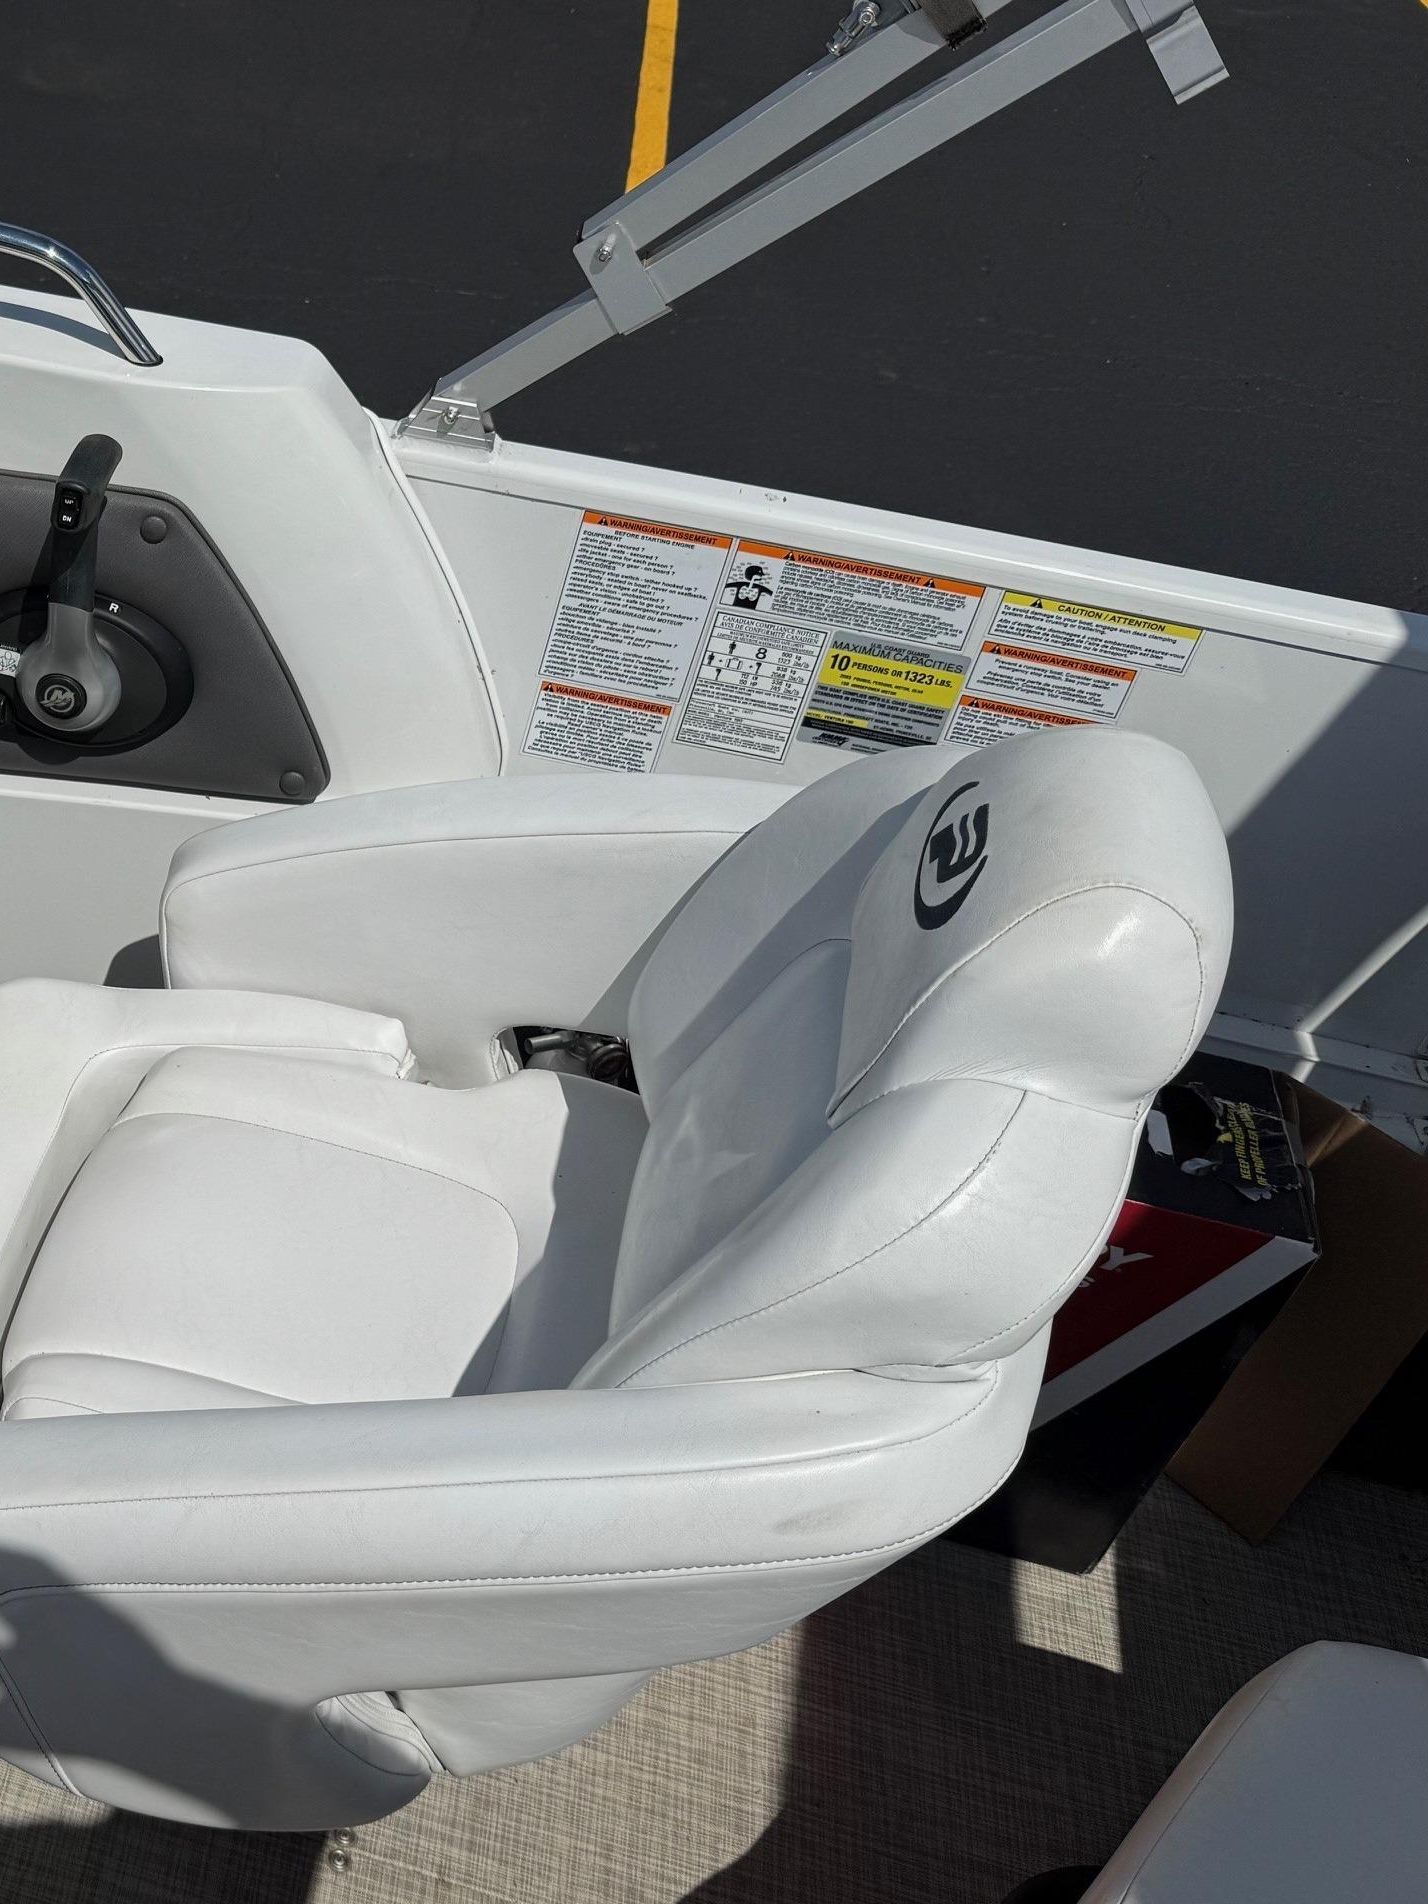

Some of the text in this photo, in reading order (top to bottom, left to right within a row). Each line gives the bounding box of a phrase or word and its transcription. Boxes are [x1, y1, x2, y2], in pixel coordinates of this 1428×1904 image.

[62, 515, 72, 524] DN
[609, 519, 718, 546] WARNING/AVERTISSEMENT
[797, 554, 922, 584] WARNING/AVERTISSEMENT
[109, 602, 120, 613] R
[1057, 604, 1103, 620] CAUTION
[1108, 615, 1166, 632] ATTENTION
[719, 620, 735, 629] AVIS
[785, 633, 819, 645] CANADIEN
[722, 615, 821, 639] CANADIAN COMPLIANCE NOTICE
[755, 647, 769, 660] 8
[832, 641, 891, 659] MAXIMUM
[892, 652, 964, 673] CAPACITIES
[883, 645, 905, 653] COAST
[906, 650, 930, 658] GUARD
[1002, 648, 1128, 678] WARNING/AVERTISSEMENT
[827, 653, 954, 688] 10 PERSONS OR 1323 LBS.
[555, 686, 667, 714] WARNING/AVERTISSEMENT
[1232, 1127, 1246, 1158] FINGERS
[1247, 1129, 1266, 1175] PROPELLER
[1238, 1158, 1252, 1181] KEEP
[1256, 1174, 1268, 1186] OF
